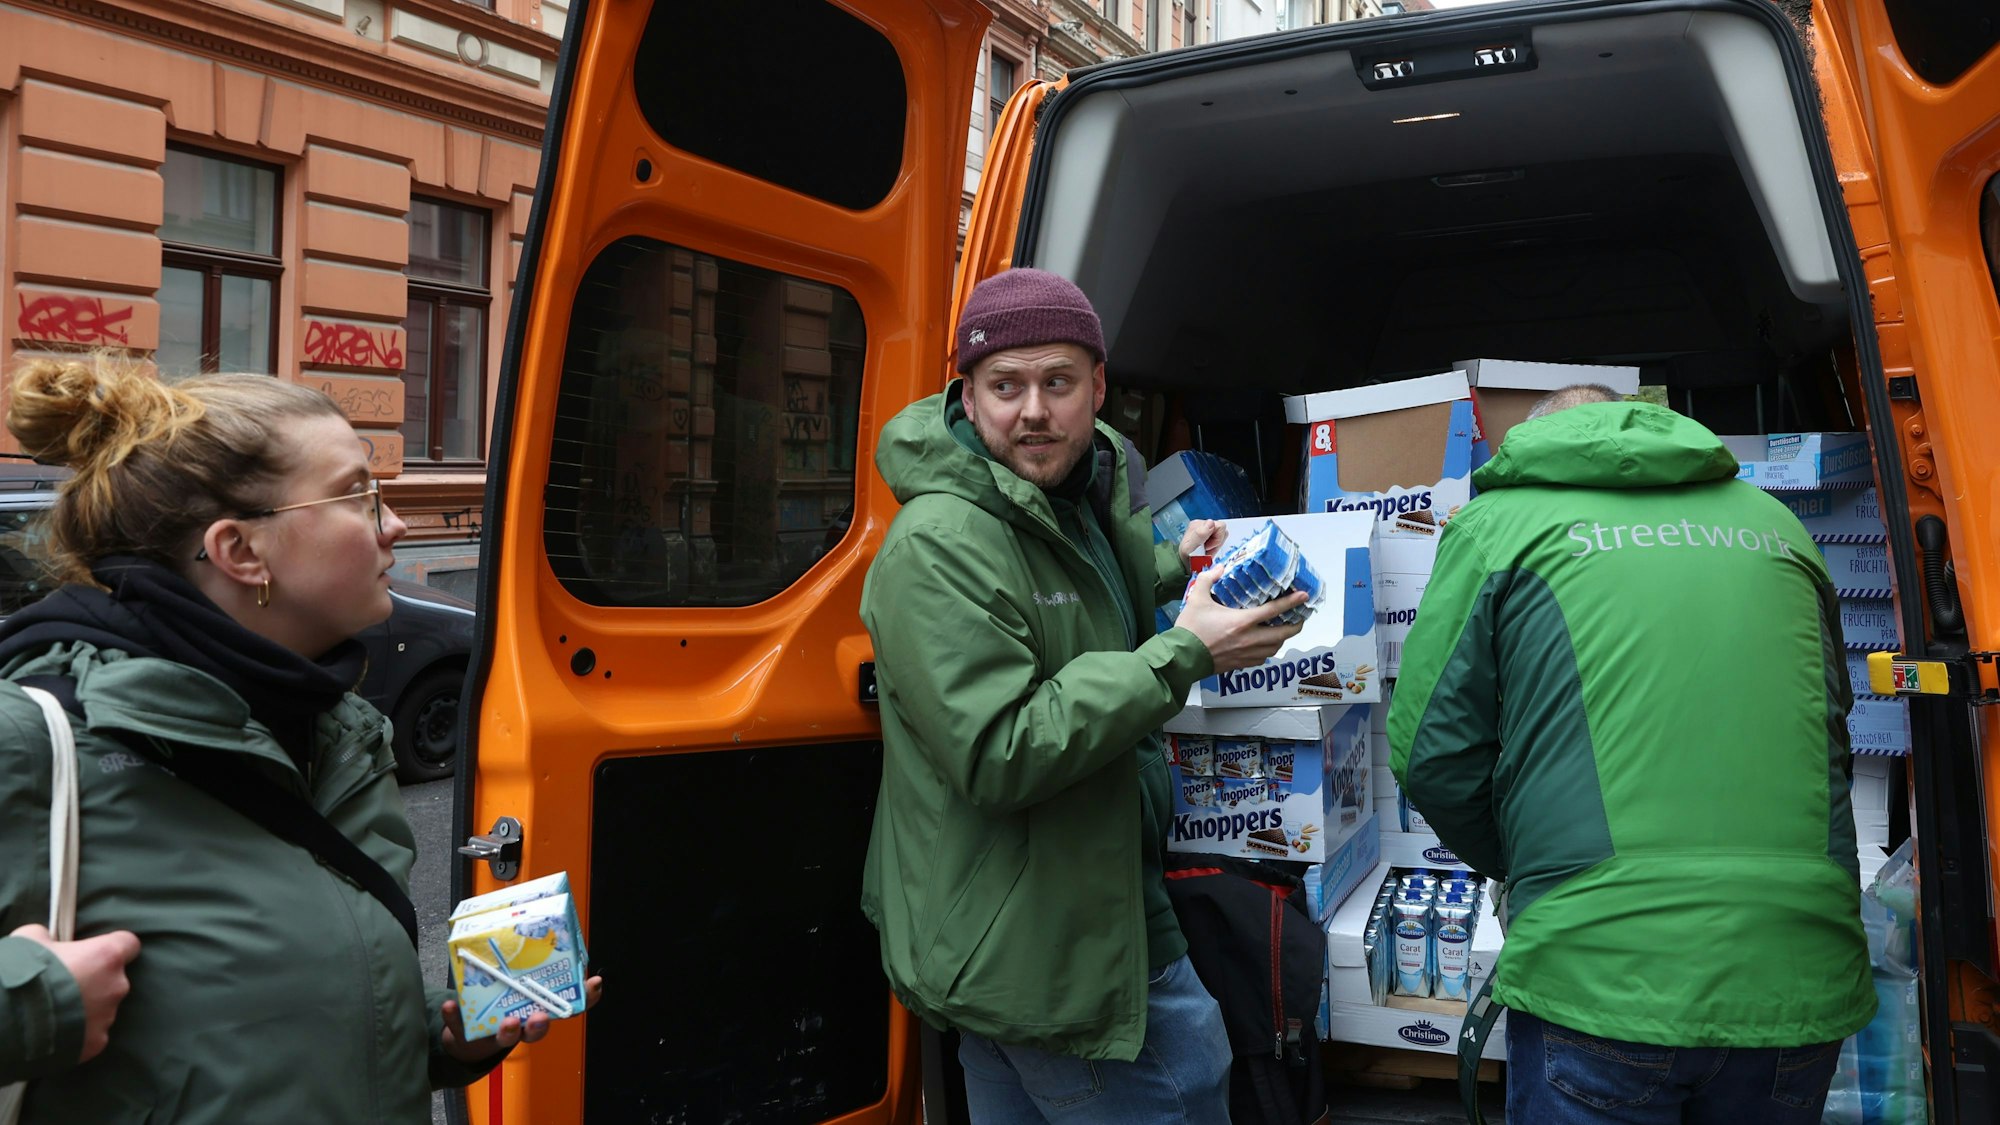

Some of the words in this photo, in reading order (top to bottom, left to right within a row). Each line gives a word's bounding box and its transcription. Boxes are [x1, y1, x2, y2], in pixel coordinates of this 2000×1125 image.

[1769, 435, 1801, 447] Durstlöscher
[1790, 498, 1825, 516] cher
[1567, 518, 1798, 562] Streetwork
[1386, 607, 1417, 626] nop
[1219, 651, 1336, 698] Knoppers
[1216, 746, 1258, 763] noppers
[1183, 780, 1211, 797] ppers
[1174, 807, 1283, 842] Knoppers
[1396, 927, 1425, 936] Christinen
[1438, 932, 1468, 941] Christinen
[1400, 943, 1421, 953] Carat
[1442, 947, 1464, 957] Carat
[1402, 1027, 1446, 1041] Christinen
